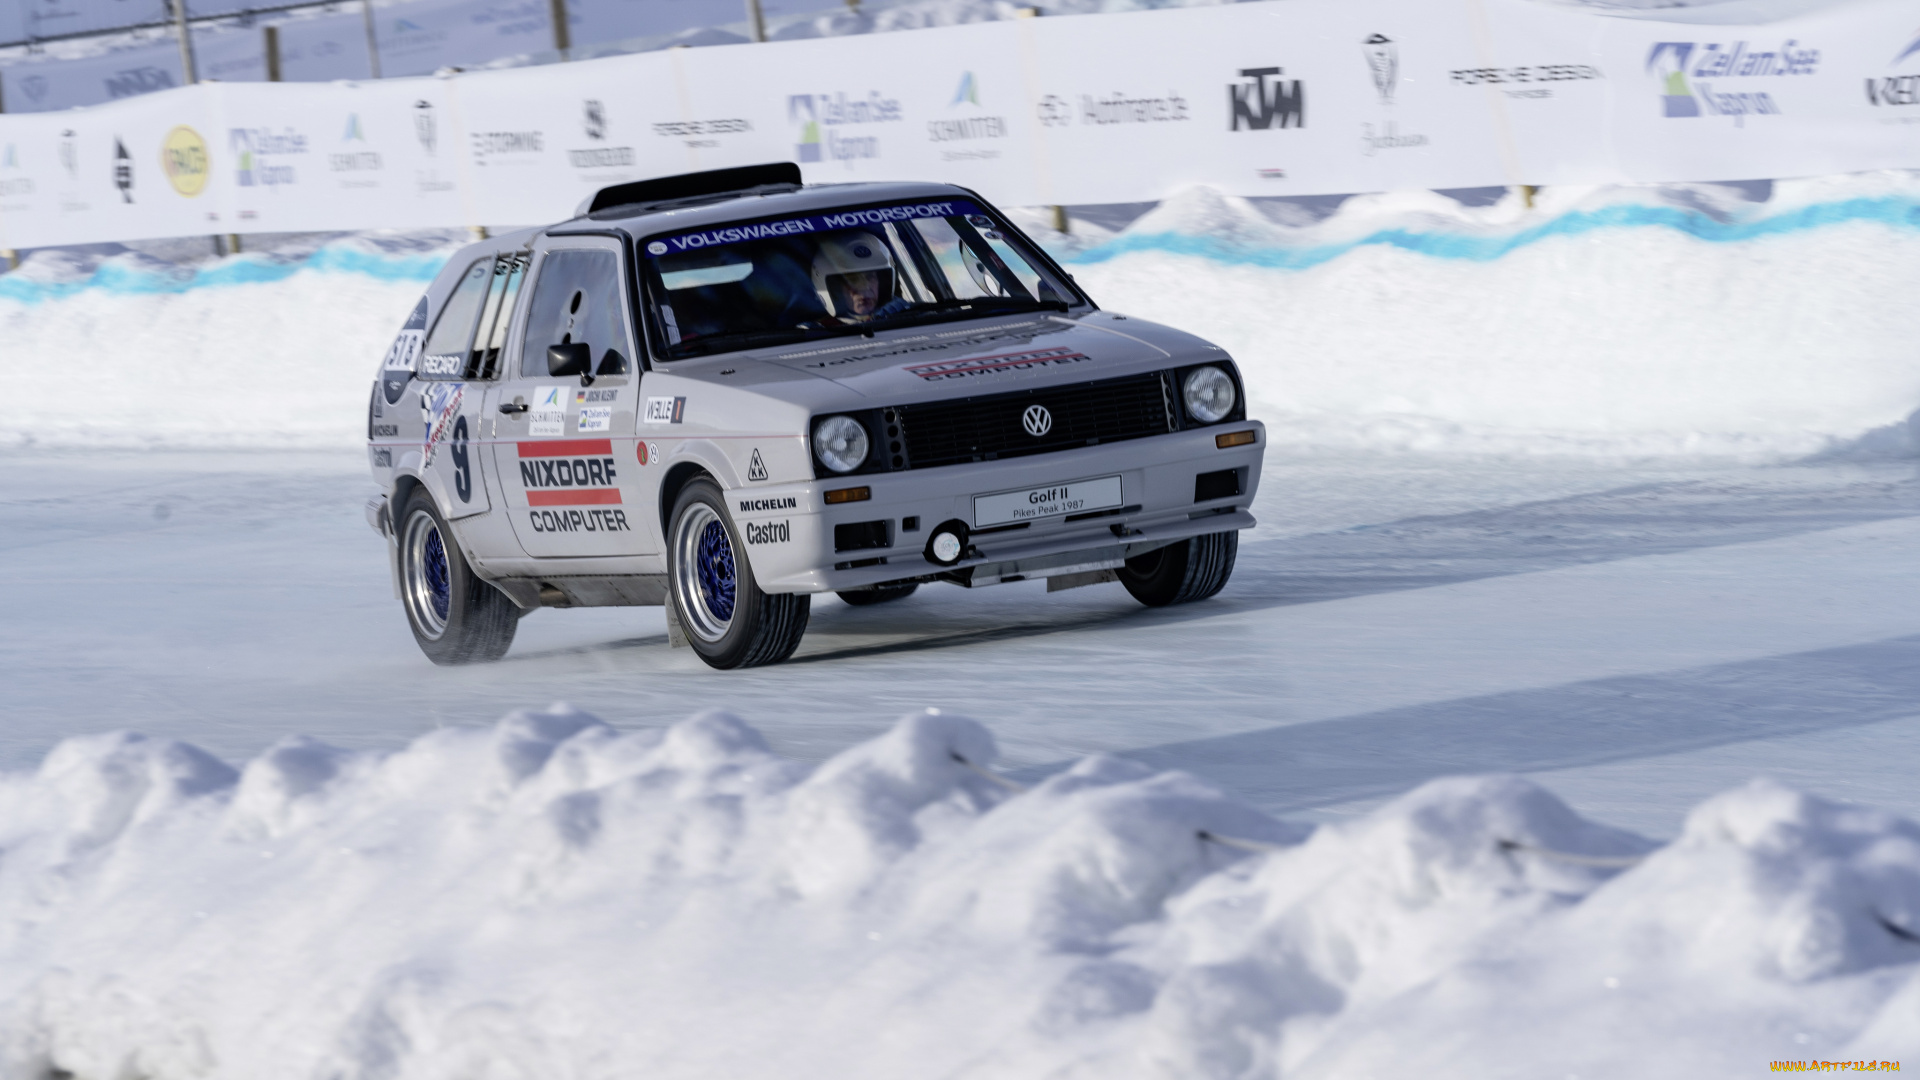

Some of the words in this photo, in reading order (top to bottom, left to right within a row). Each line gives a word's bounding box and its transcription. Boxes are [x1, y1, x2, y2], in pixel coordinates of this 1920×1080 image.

[1226, 66, 1306, 132] KTM
[671, 218, 815, 250] VOLKSWAGEN
[823, 203, 952, 228] MOTORSPORT
[422, 354, 461, 375] RECARO
[909, 348, 1074, 375] NIXDORF
[923, 354, 1092, 382] COMPUTER
[451, 415, 472, 504] 9
[520, 458, 617, 488] NIXDORF
[740, 497, 797, 512] MICHELIN
[1013, 509, 1036, 518] Pikes
[1038, 505, 1059, 515] Peak
[1062, 500, 1084, 511] 1987
[1029, 488, 1057, 504] Golf
[530, 510, 631, 532] COMPUTER
[746, 519, 790, 545] Castrol
